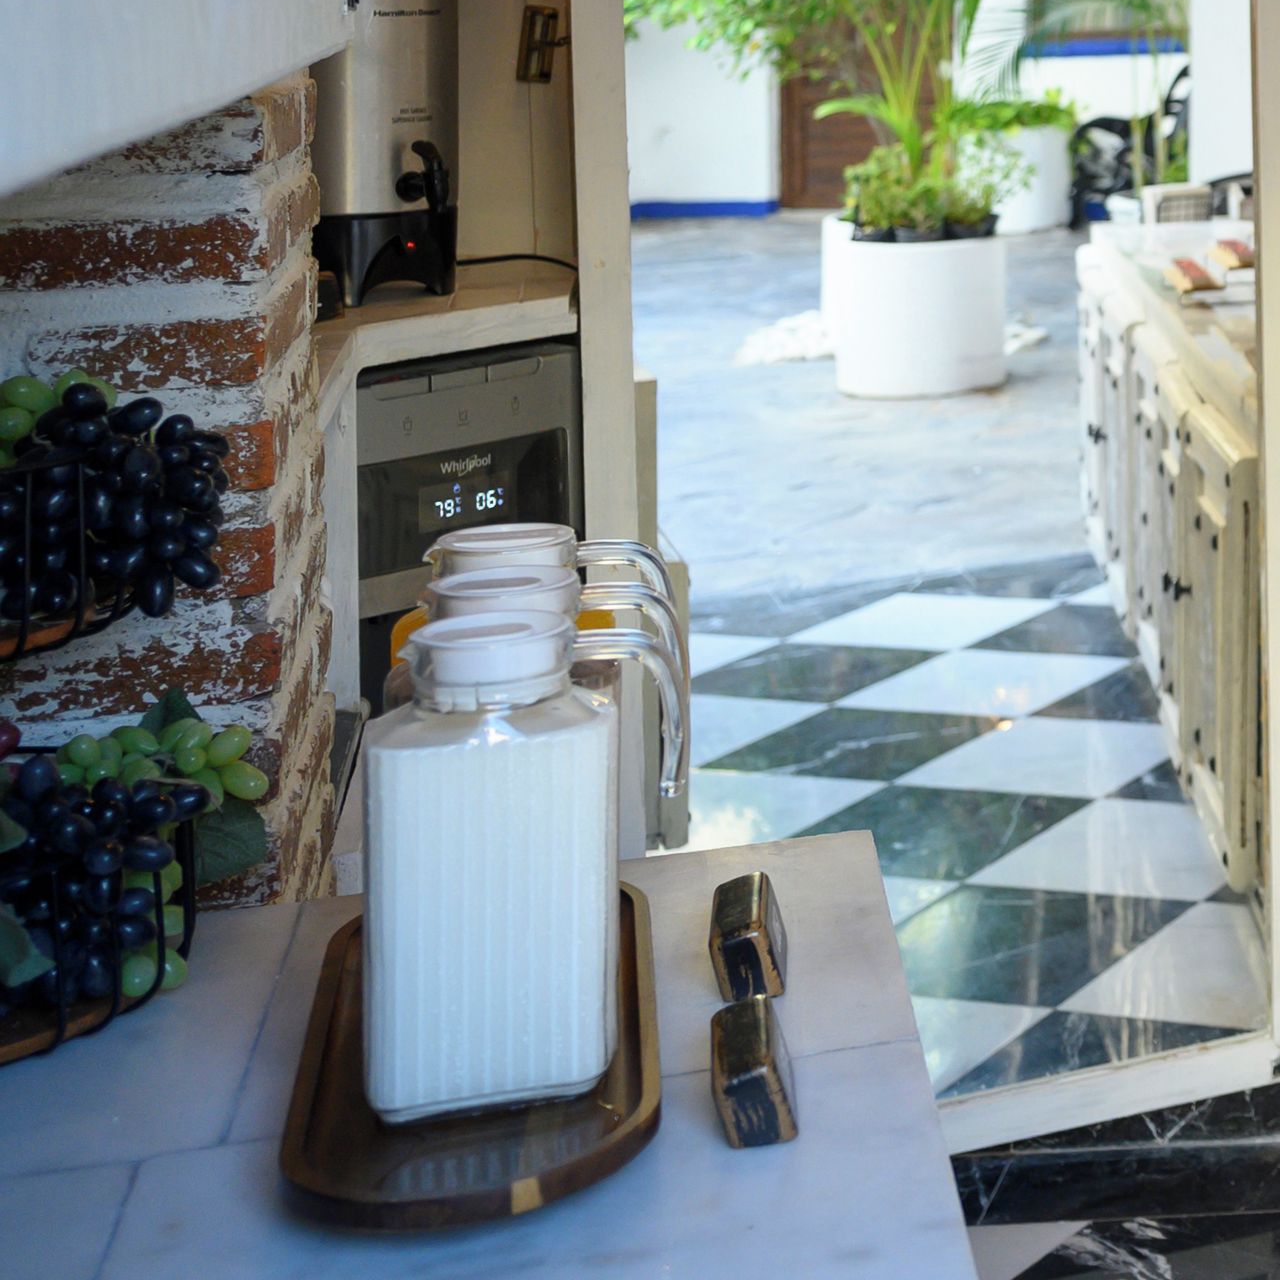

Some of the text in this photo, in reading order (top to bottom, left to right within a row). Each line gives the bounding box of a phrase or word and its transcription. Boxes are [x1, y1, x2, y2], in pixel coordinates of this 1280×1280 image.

[440, 453, 492, 477] Whirlpool
[435, 498, 454, 518] 79
[476, 490, 496, 510] 06
